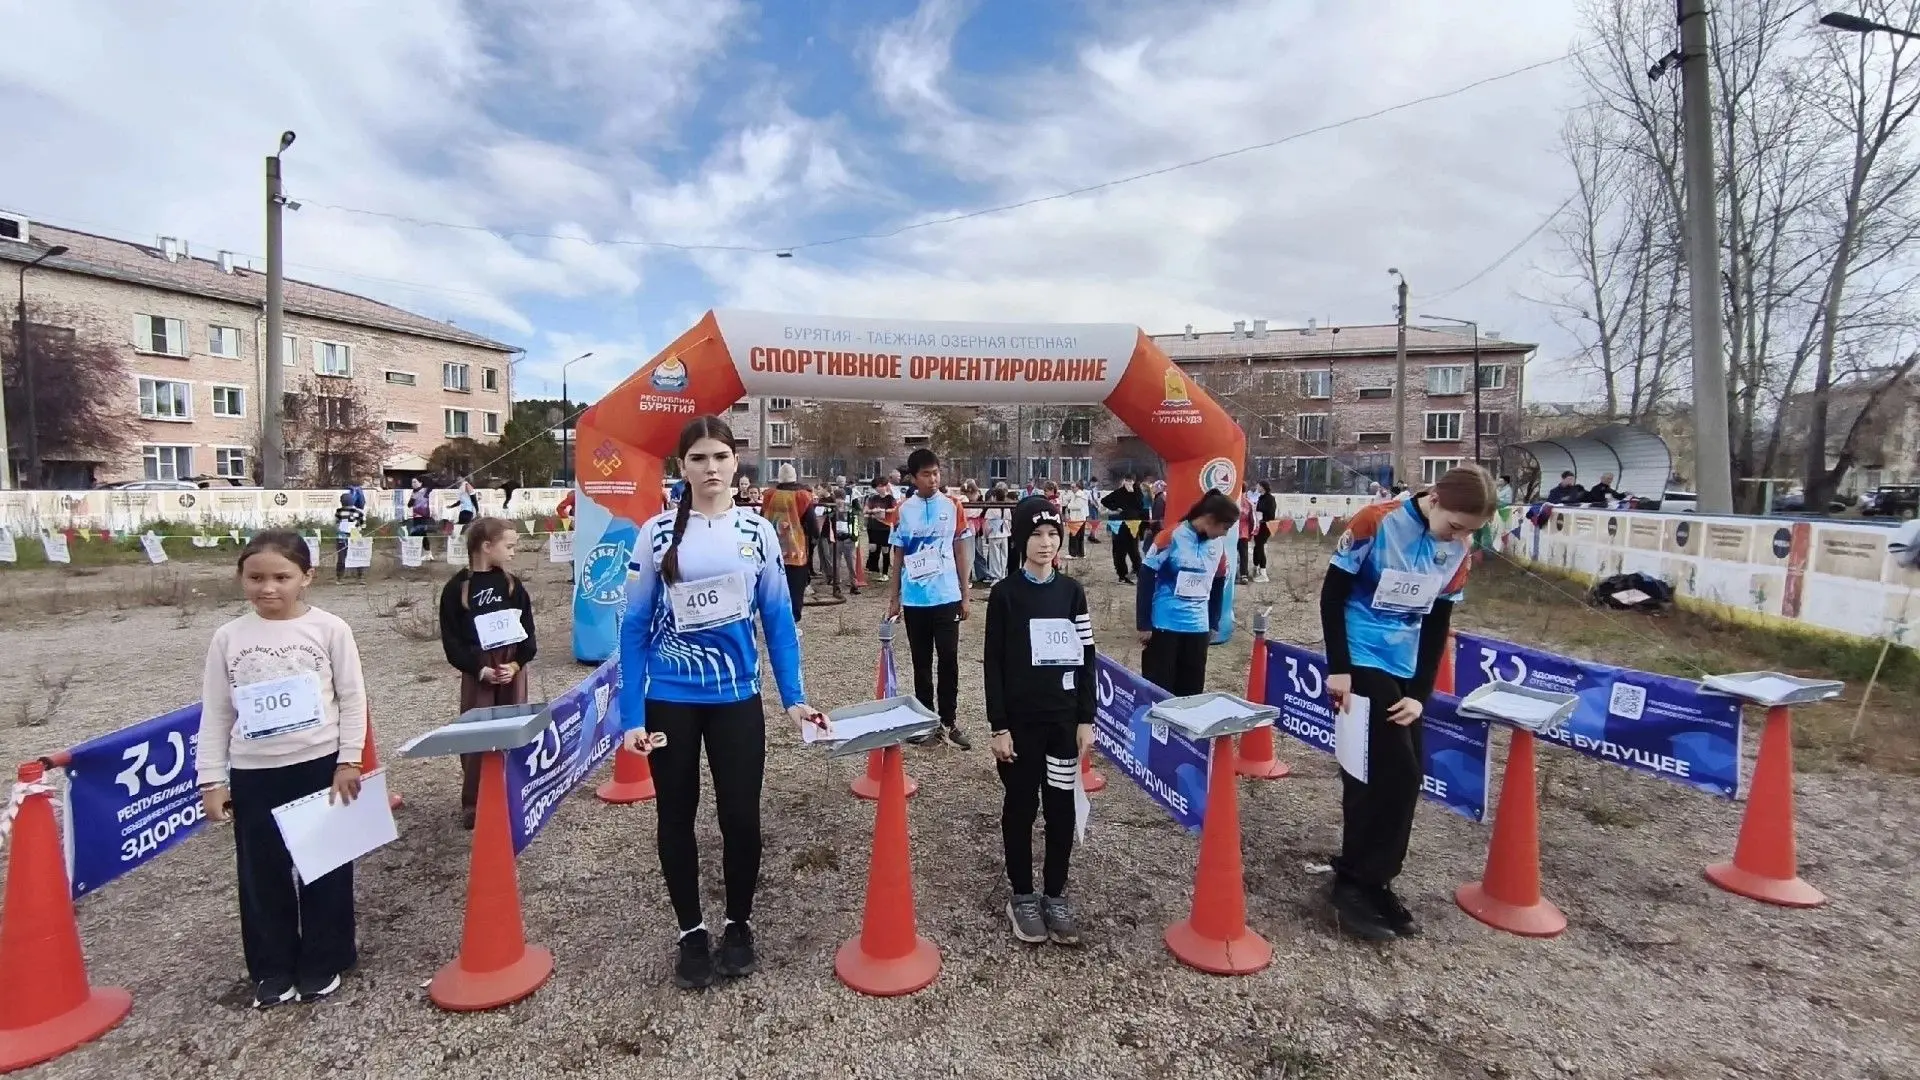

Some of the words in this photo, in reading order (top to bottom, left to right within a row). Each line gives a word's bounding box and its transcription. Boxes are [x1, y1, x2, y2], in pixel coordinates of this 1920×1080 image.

[784, 326, 851, 342] БУРЯТИЯ
[941, 334, 1006, 349] ОЗЕРНАЯ
[1010, 336, 1077, 349] СТЕПНАЯ!
[750, 346, 902, 379] СПОРТИВНОЕ
[909, 355, 1108, 382] ОРИЕНТИРОВАНИЕ
[639, 401, 696, 413] БУРЯТИЯ
[640, 394, 696, 405] РЕСПУБЛИКА
[1159, 416, 1203, 424] УЛАН-УДЭ
[912, 557, 926, 569] 307
[686, 589, 719, 609] 406
[1391, 582, 1420, 596] 206
[489, 618, 510, 632] 507
[1045, 631, 1069, 644] 306
[1531, 669, 1577, 687] ЗДОРОВОЕ
[254, 692, 292, 714] 506
[1284, 693, 1330, 718] РЕСПУБЛИКА
[1282, 713, 1337, 748] ЗДОРОВ
[1574, 734, 1691, 778] БУДУЩЕЕ
[1135, 761, 1189, 816] БУДУЩЕЕ
[117, 778, 193, 823] РЕСПУБЛИКА
[121, 799, 207, 861] ЗДОРОВ
